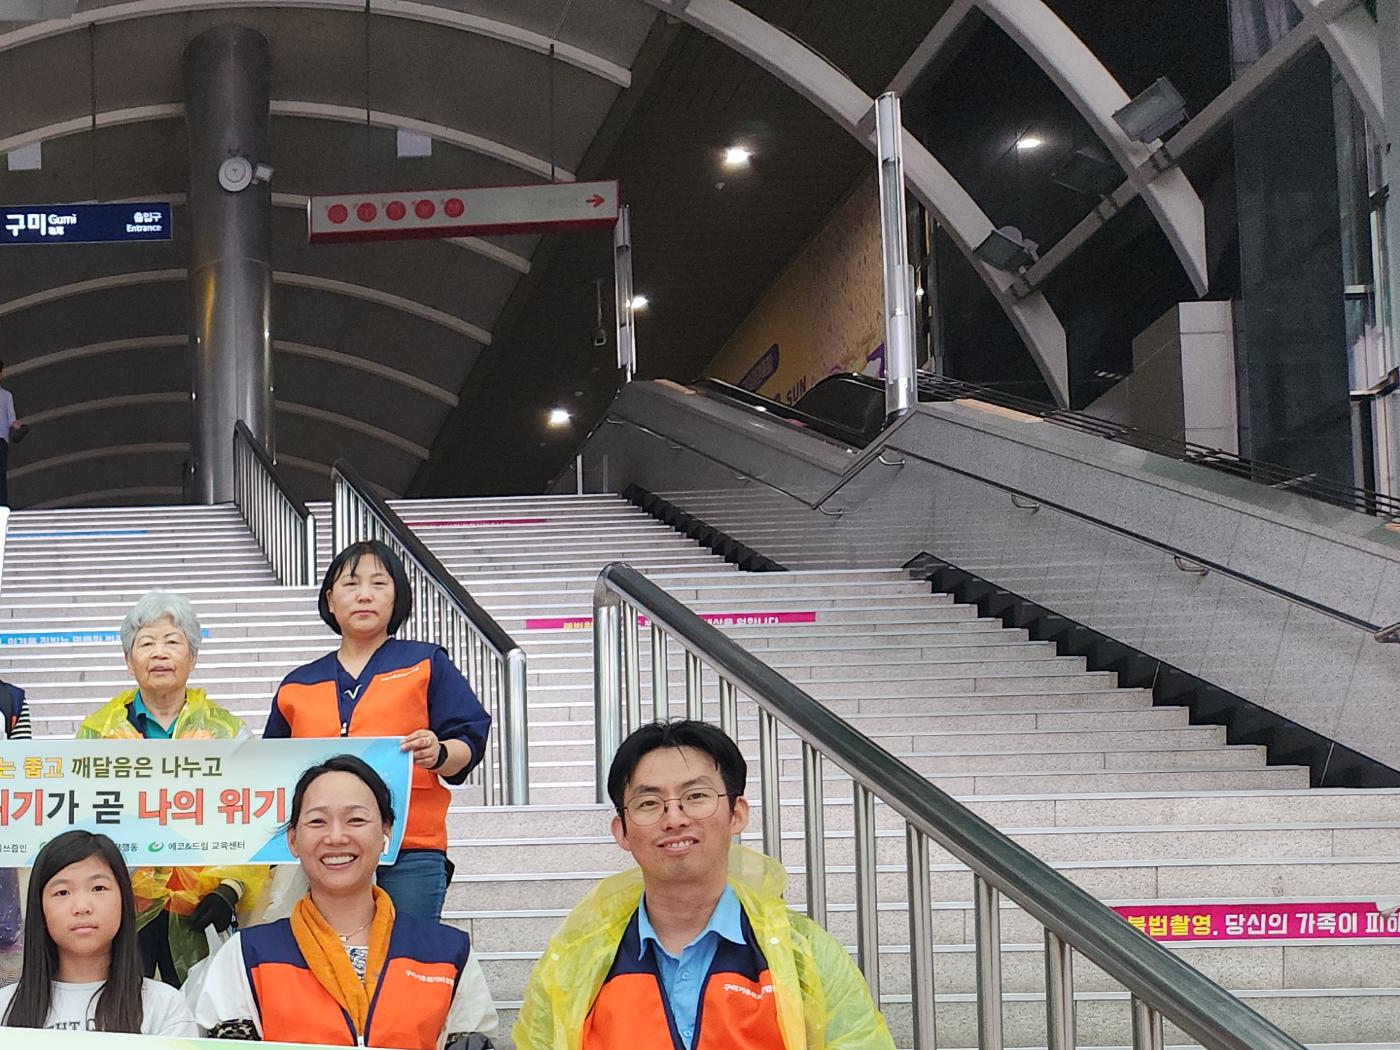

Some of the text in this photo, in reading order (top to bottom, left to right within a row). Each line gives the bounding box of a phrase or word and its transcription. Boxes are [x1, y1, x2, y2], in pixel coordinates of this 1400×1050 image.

[5, 213, 46, 236] 구미
[48, 213, 77, 225] Gumi
[133, 212, 162, 223] 출입구
[126, 224, 162, 233] Entrance
[23, 756, 65, 779] 줍고
[72, 756, 153, 779] 깨달음은
[162, 756, 222, 778] 나누고
[92, 790, 124, 825] 곧
[138, 788, 204, 826] 나의
[218, 787, 286, 825] 위기
[168, 840, 246, 851] 에코&드림 교육센터
[1225, 913, 1287, 935] 당신의
[1295, 912, 1357, 934] 가족이
